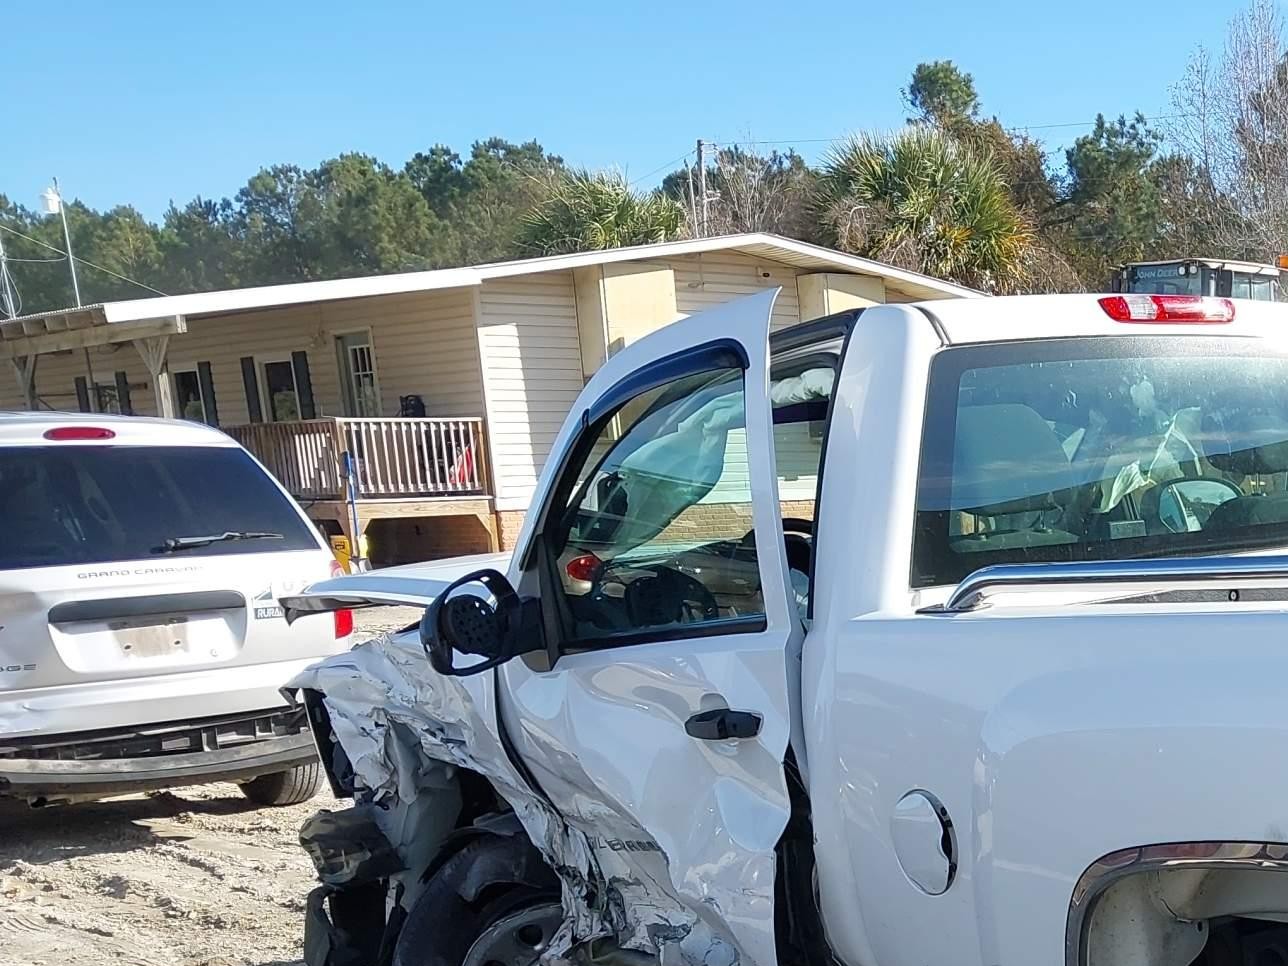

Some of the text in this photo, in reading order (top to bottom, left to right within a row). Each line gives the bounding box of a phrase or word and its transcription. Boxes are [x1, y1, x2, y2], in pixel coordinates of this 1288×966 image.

[1136, 267, 1179, 279] JOHN DEER
[77, 569, 130, 580] GRAND
